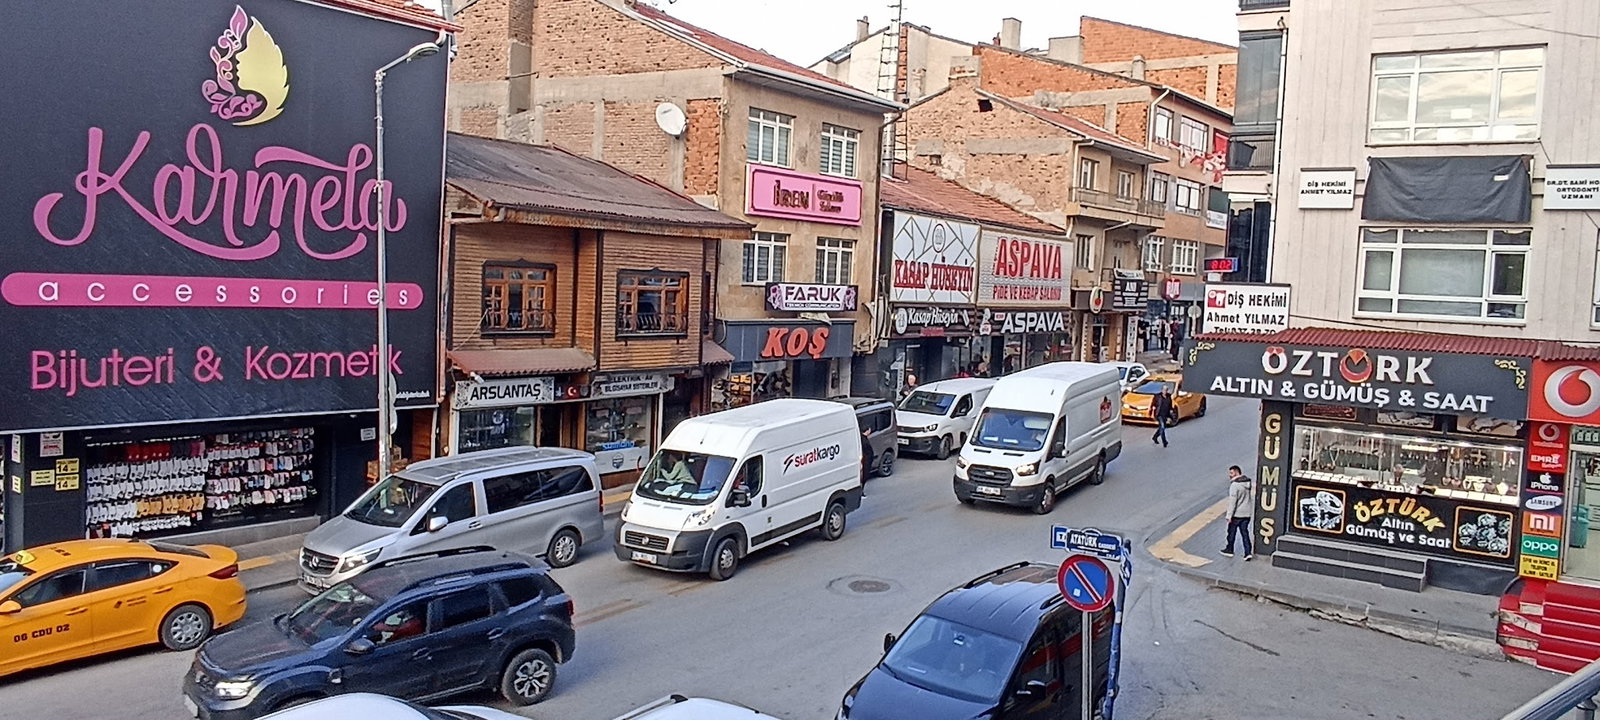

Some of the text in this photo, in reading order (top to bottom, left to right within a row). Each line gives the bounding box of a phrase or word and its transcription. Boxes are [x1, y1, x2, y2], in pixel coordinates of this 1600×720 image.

[33, 123, 407, 261] Karmela
[994, 238, 1062, 279] ASPAVA
[893, 259, 929, 289] KASAP
[38, 281, 408, 305] accessories
[785, 286, 841, 302] FARUK
[1227, 291, 1287, 309] DİŞ HEKİMİ
[1000, 312, 1065, 334] ASPAVA
[1207, 312, 1285, 326] Ahmet YILMAZ
[761, 327, 829, 360] KOŞ
[31, 344, 403, 396] Bijuteri & Kozmetk
[470, 383, 541, 401] ARSLANTAŞ
[1210, 375, 1493, 413] ALTIN & GÜMÜŞ & SAAT
[57, 481, 69, 489] 14
[1260, 413, 1281, 545] GÜMÜŞ
[1354, 497, 1446, 532] ÖZTÜRK
[1381, 517, 1415, 531] Altın
[1070, 533, 1098, 548] ATATÜRK
[1346, 524, 1452, 549] Gümüş ve Saat
[1523, 540, 1558, 552] oppo
